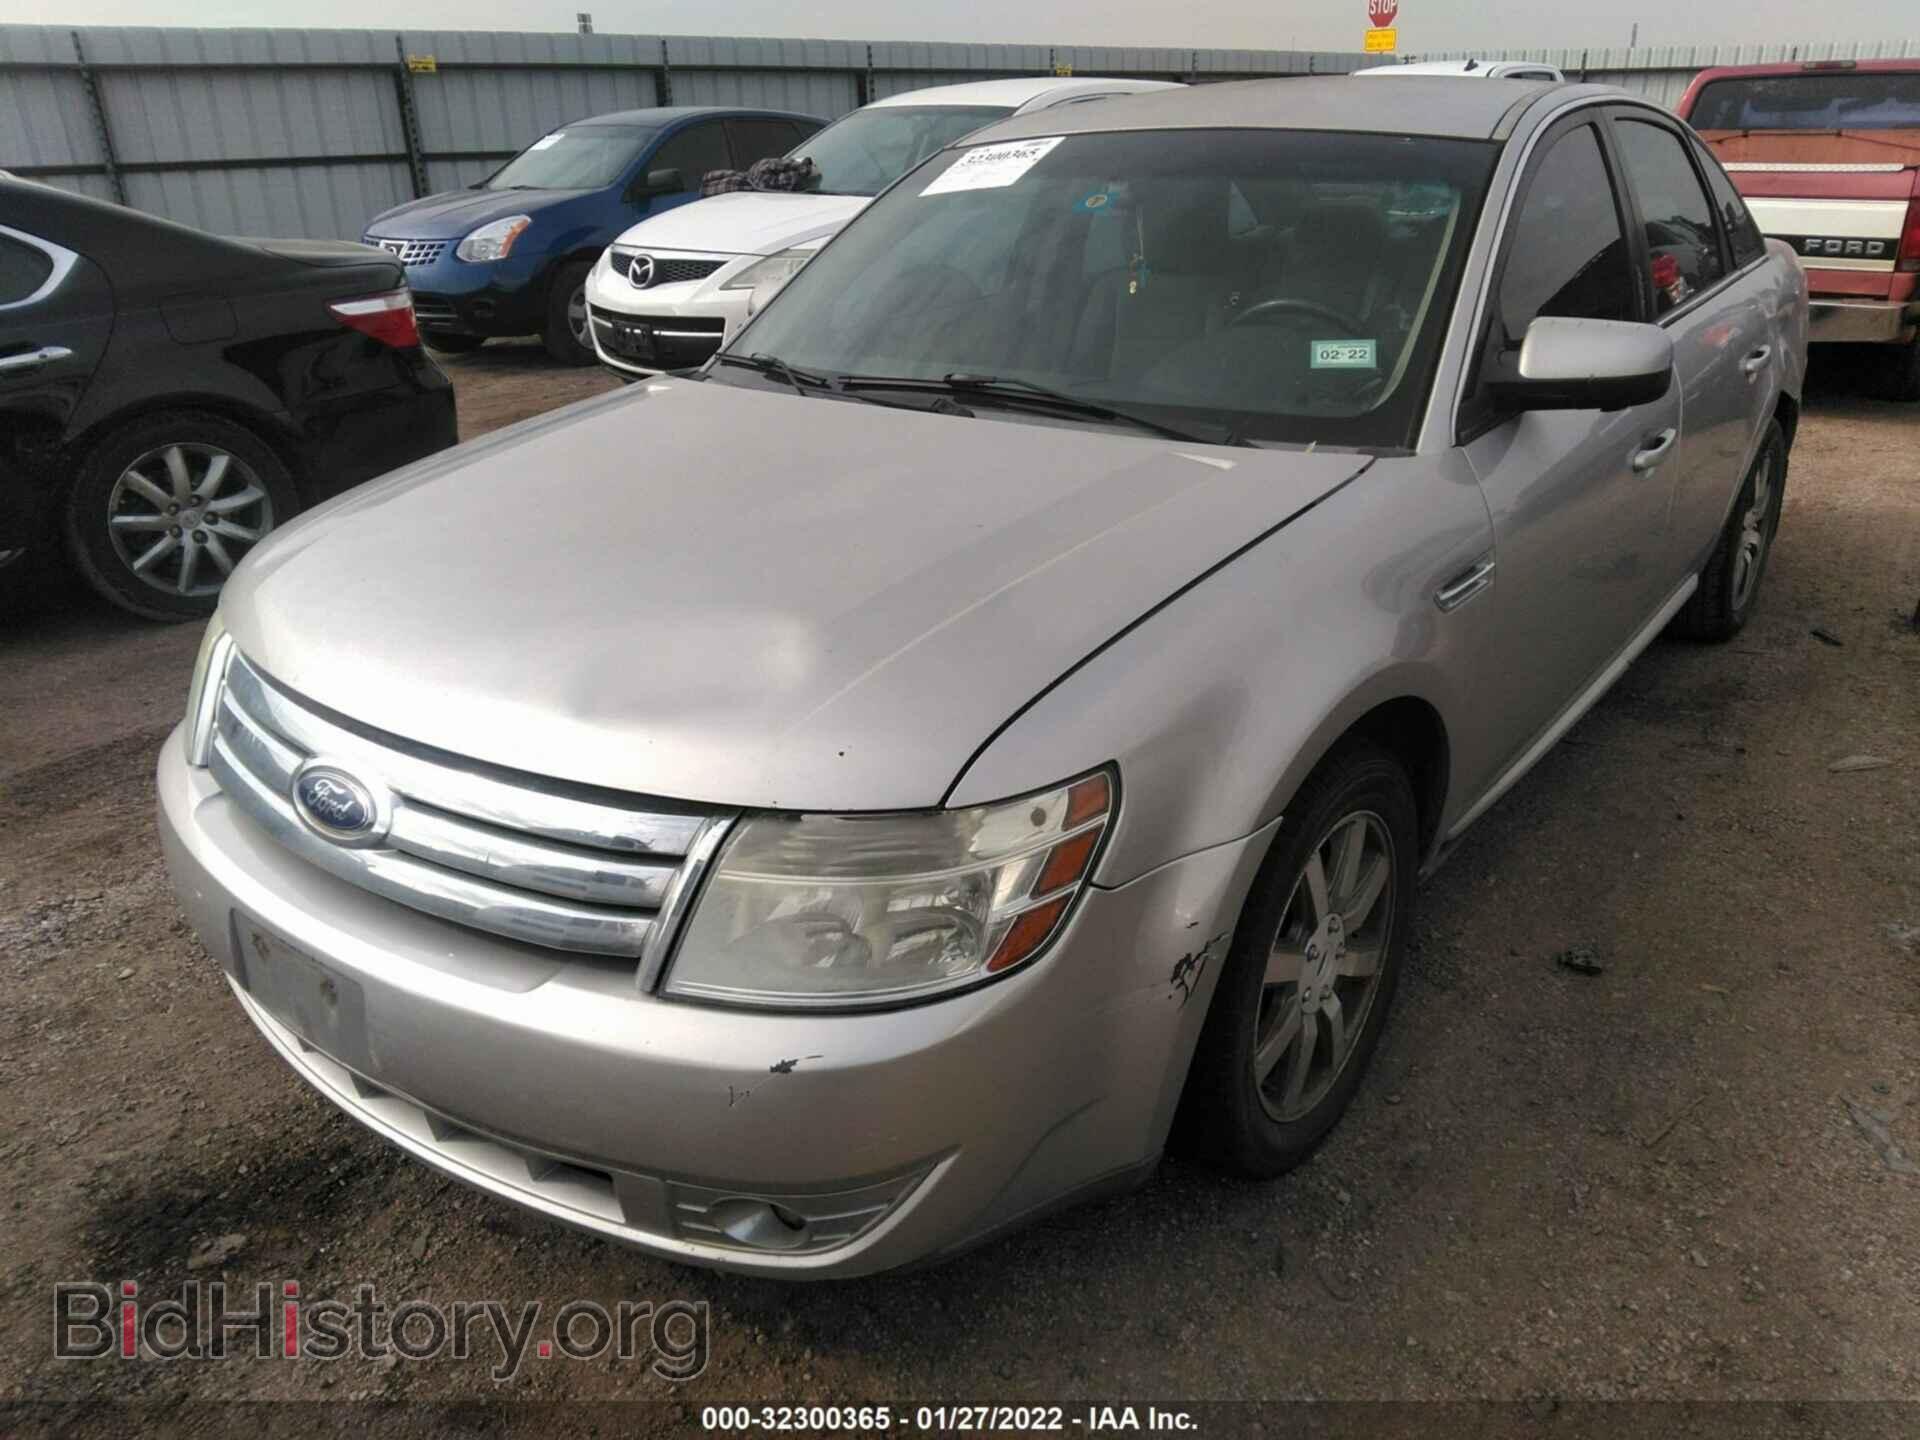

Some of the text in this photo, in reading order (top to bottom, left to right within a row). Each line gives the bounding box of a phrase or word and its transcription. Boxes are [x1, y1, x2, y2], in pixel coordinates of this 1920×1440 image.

[1370, 0, 1396, 15] STOP
[1804, 238, 1885, 254] FORD
[1320, 349, 1368, 360] 02-22
[306, 779, 354, 820] Ford
